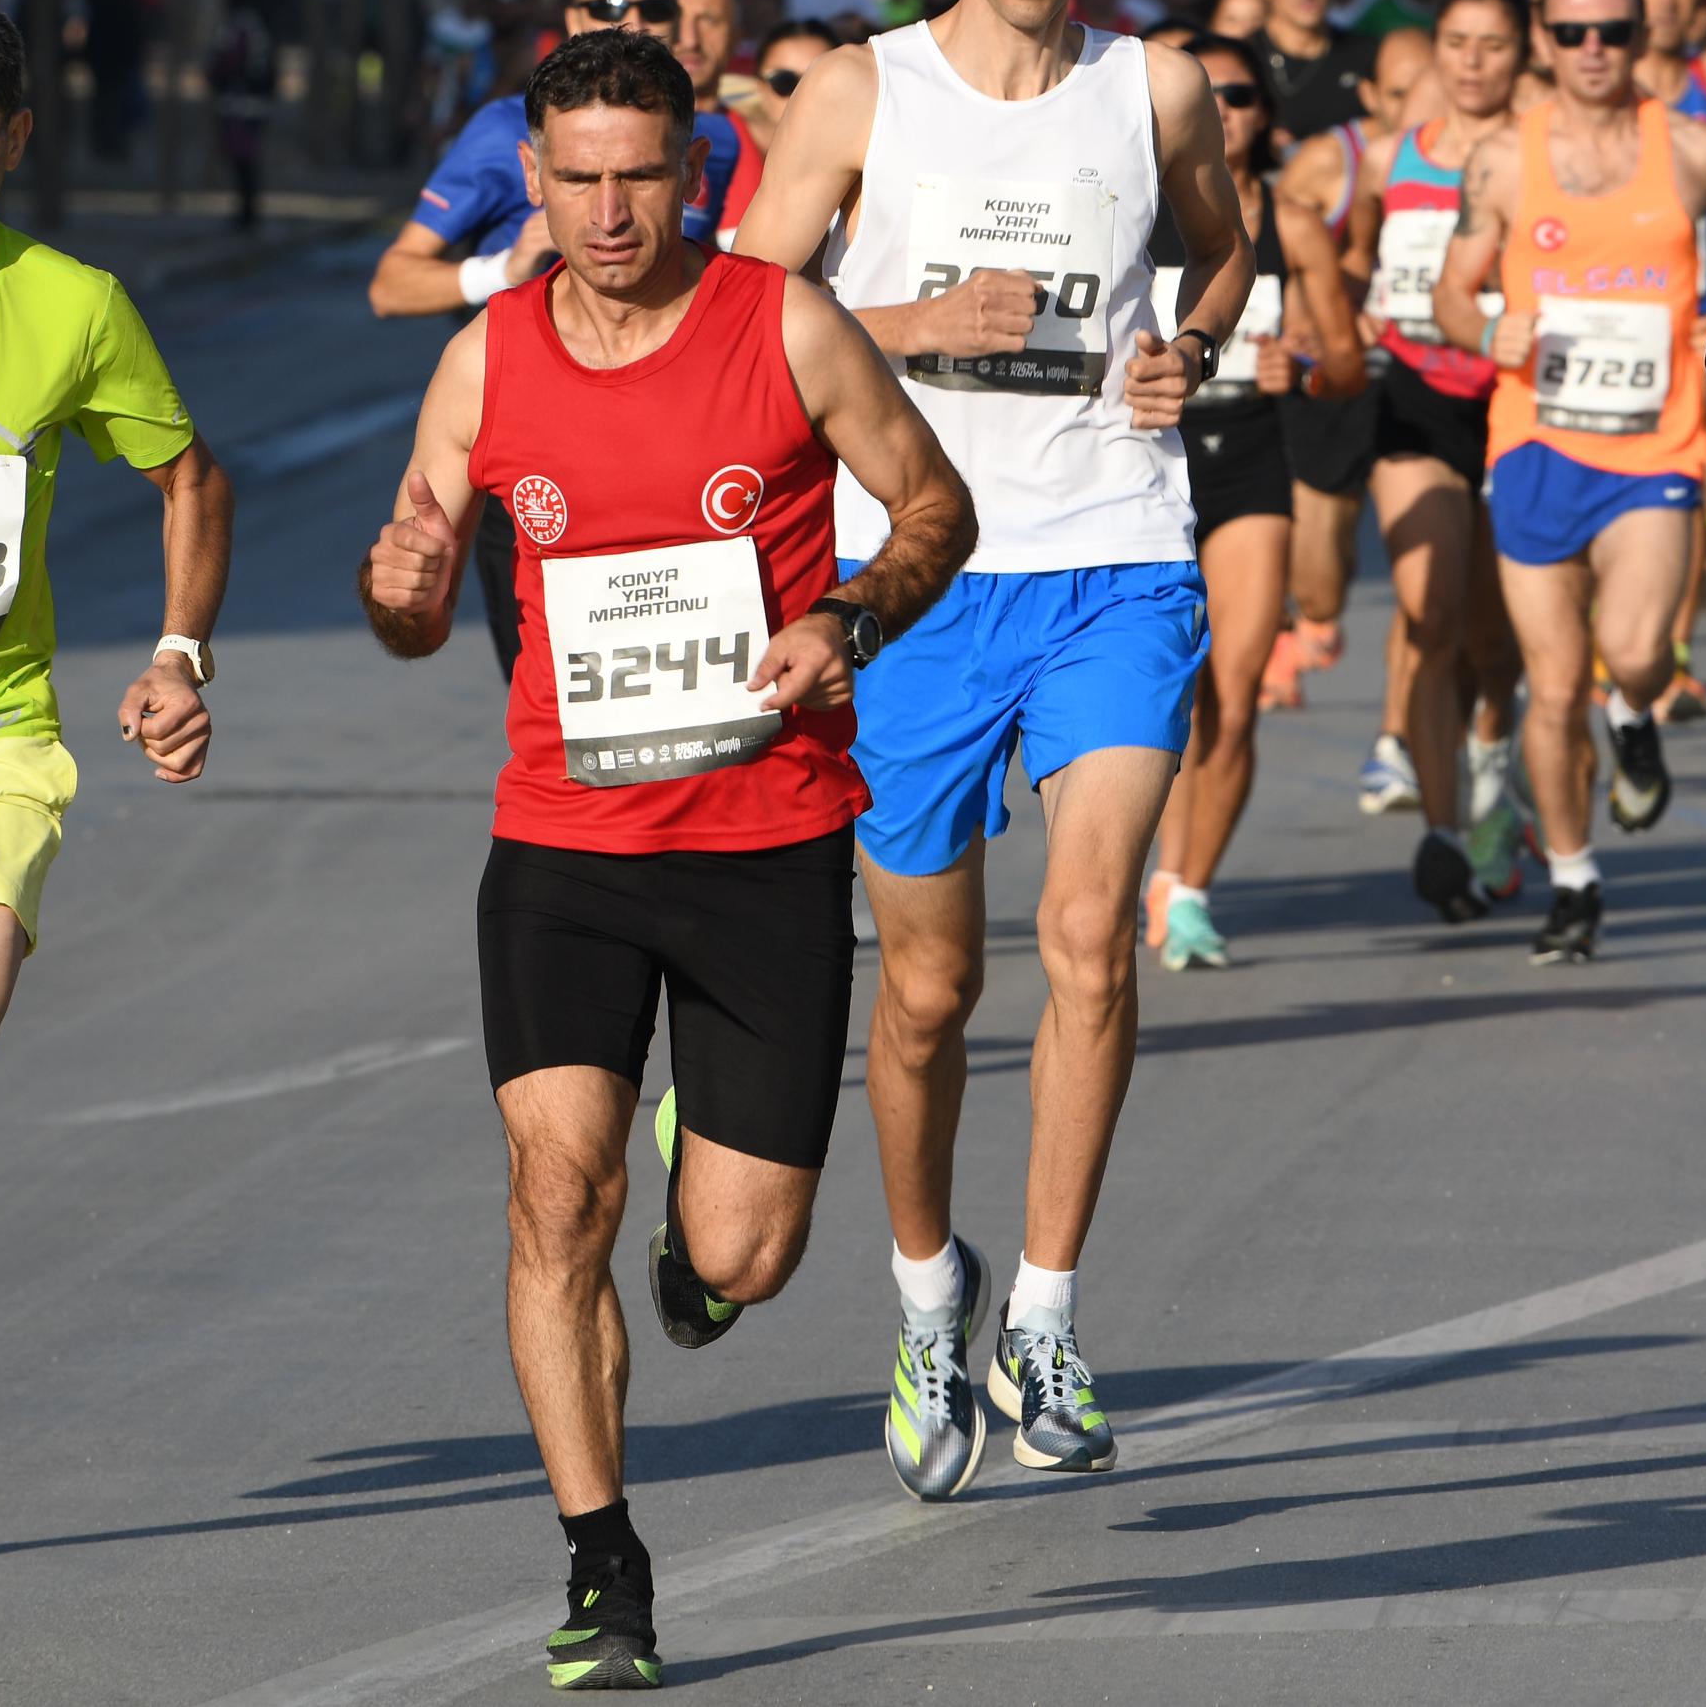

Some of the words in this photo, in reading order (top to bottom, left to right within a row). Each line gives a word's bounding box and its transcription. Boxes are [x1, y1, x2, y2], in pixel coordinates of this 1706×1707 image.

[985, 199, 1050, 215] KONYA
[995, 215, 1038, 228] YARI
[959, 227, 1071, 245] MARATONU
[917, 262, 1100, 319] 20
[1544, 354, 1655, 389] 2728
[532, 519, 549, 528] 2022
[607, 568, 679, 590] KONYA
[622, 586, 669, 603] YARI
[589, 596, 709, 624] MARATONU
[567, 631, 750, 704] 3244
